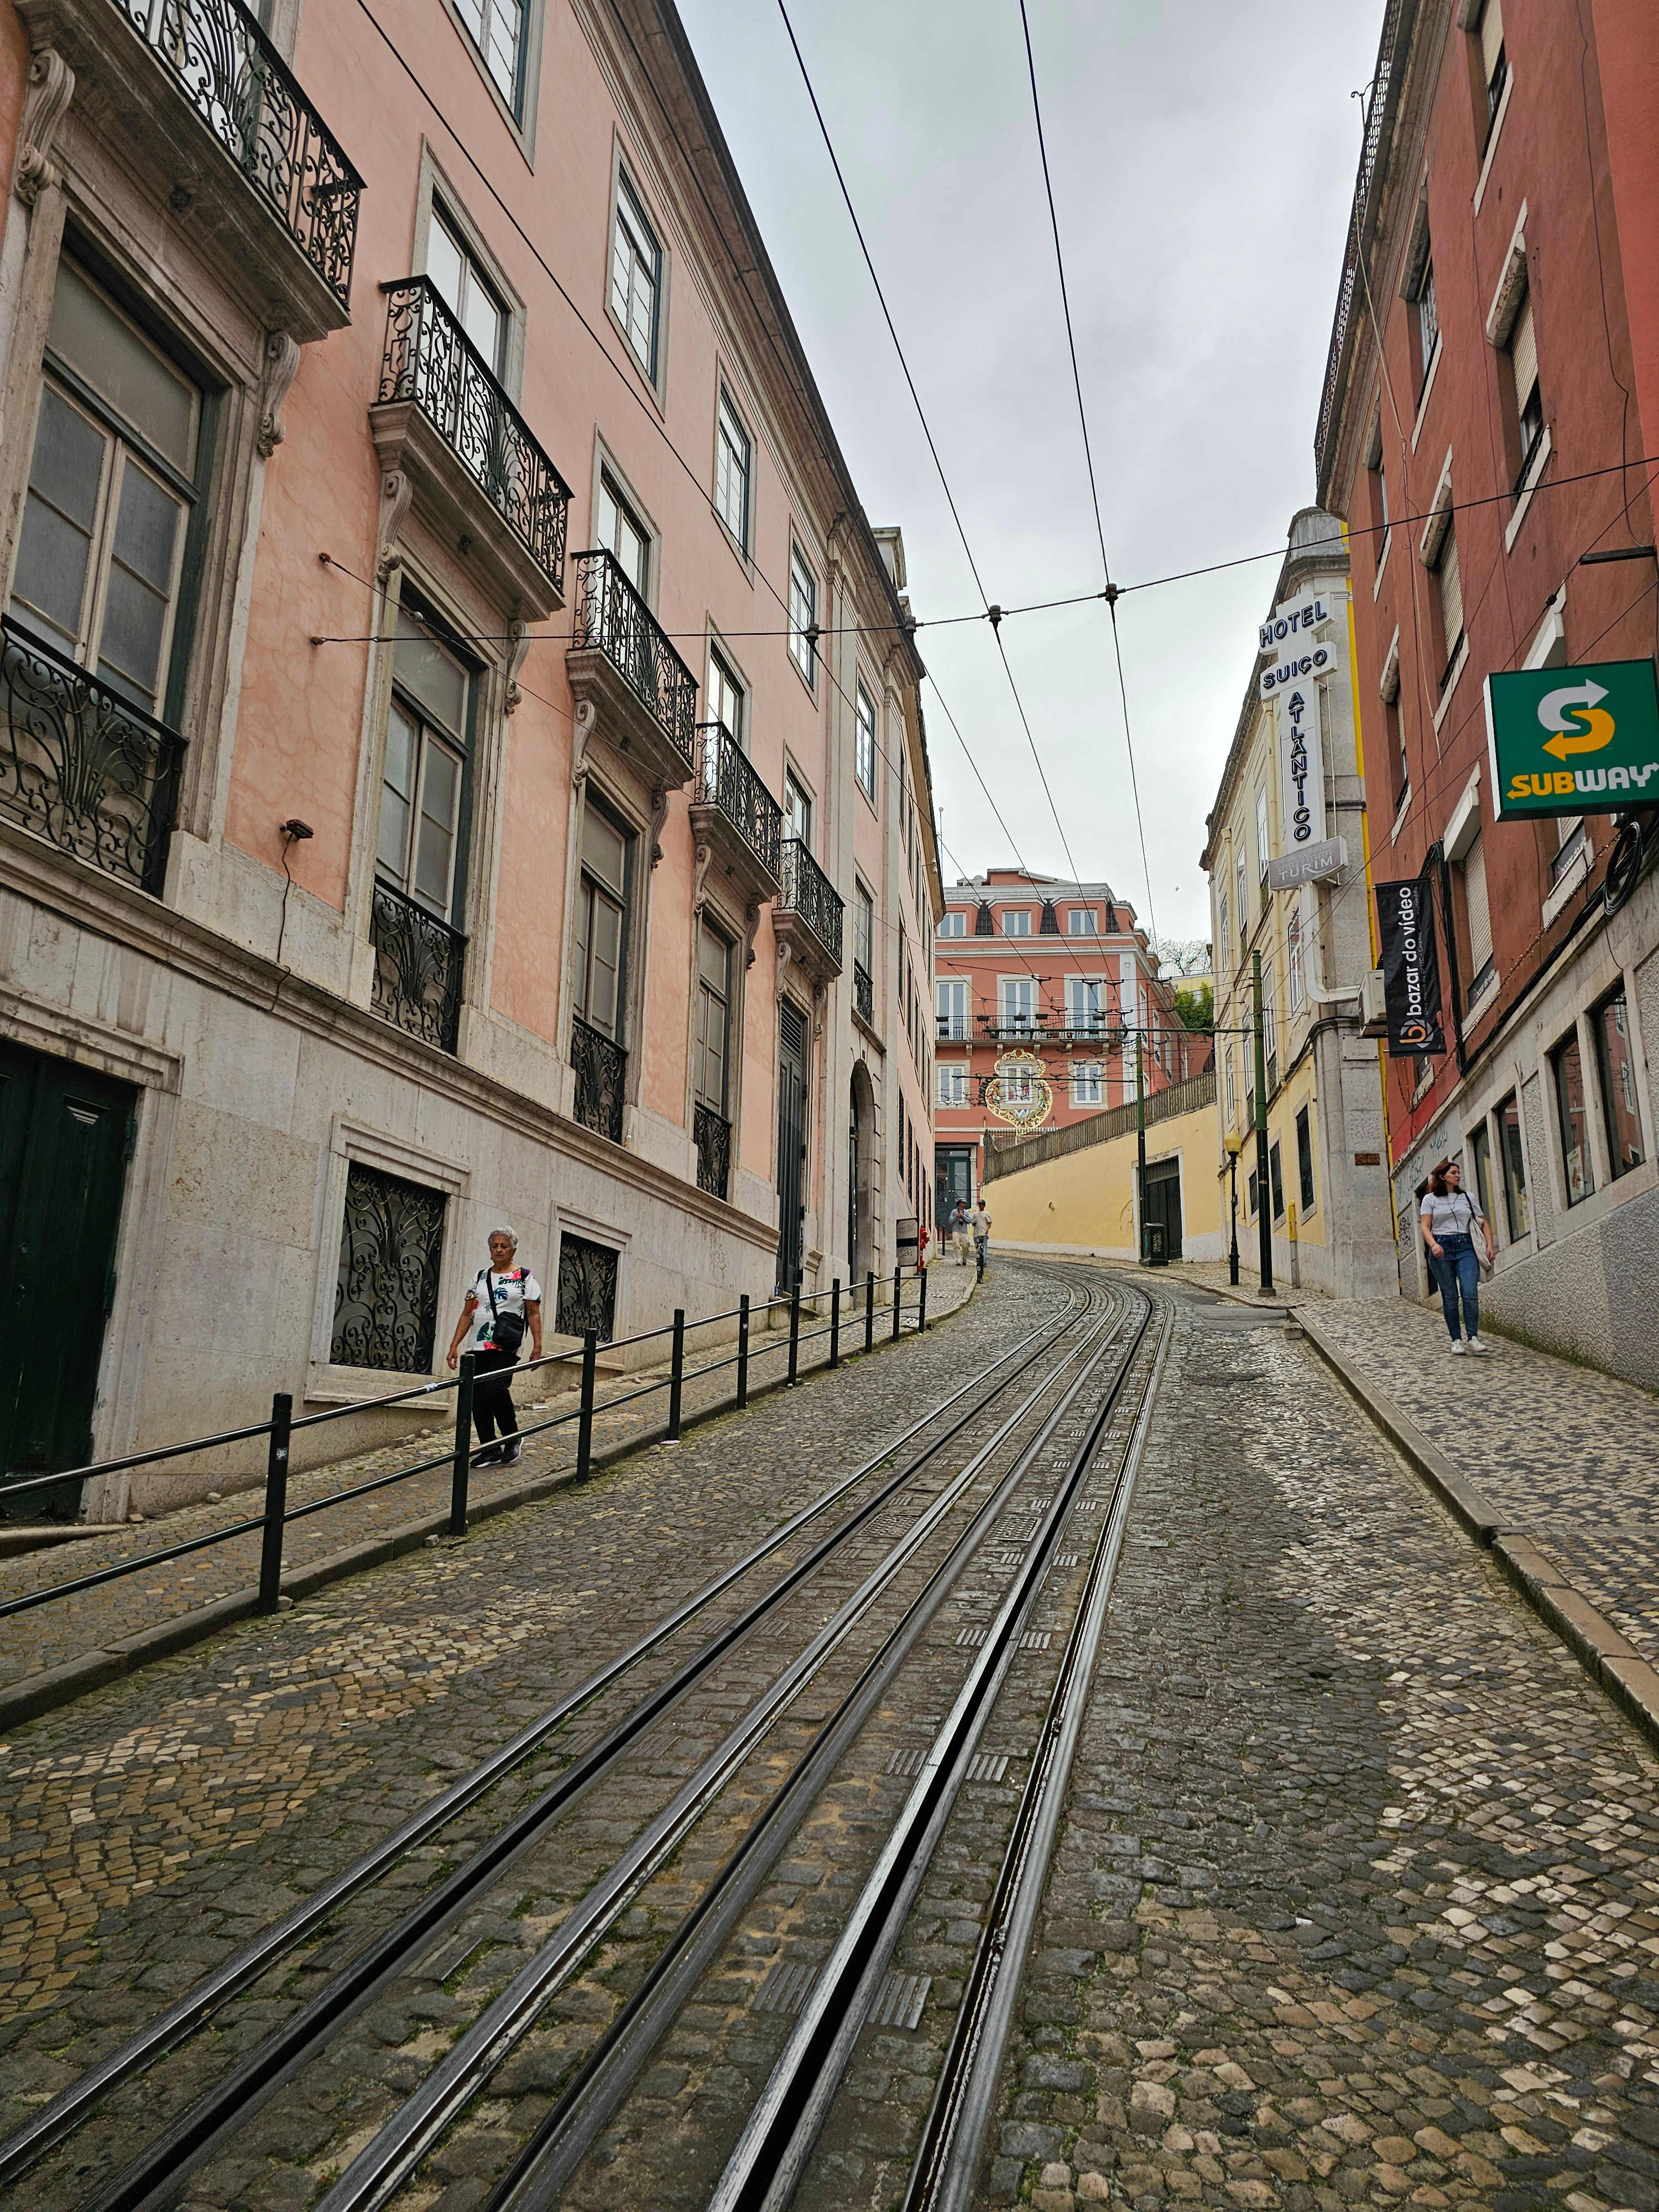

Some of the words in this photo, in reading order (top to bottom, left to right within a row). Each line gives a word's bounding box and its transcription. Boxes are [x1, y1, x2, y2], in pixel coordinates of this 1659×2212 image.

[1260, 600, 1327, 648] HOTEL
[1262, 649, 1328, 690] SUIÇO
[1287, 691, 1311, 842] ATLÂNTICO
[1506, 761, 1659, 800] SUBWAY
[1279, 855, 1332, 881] TURIM
[1398, 886, 1416, 936] vídeo
[1402, 938, 1417, 962] do
[1406, 966, 1422, 1016] bazar
